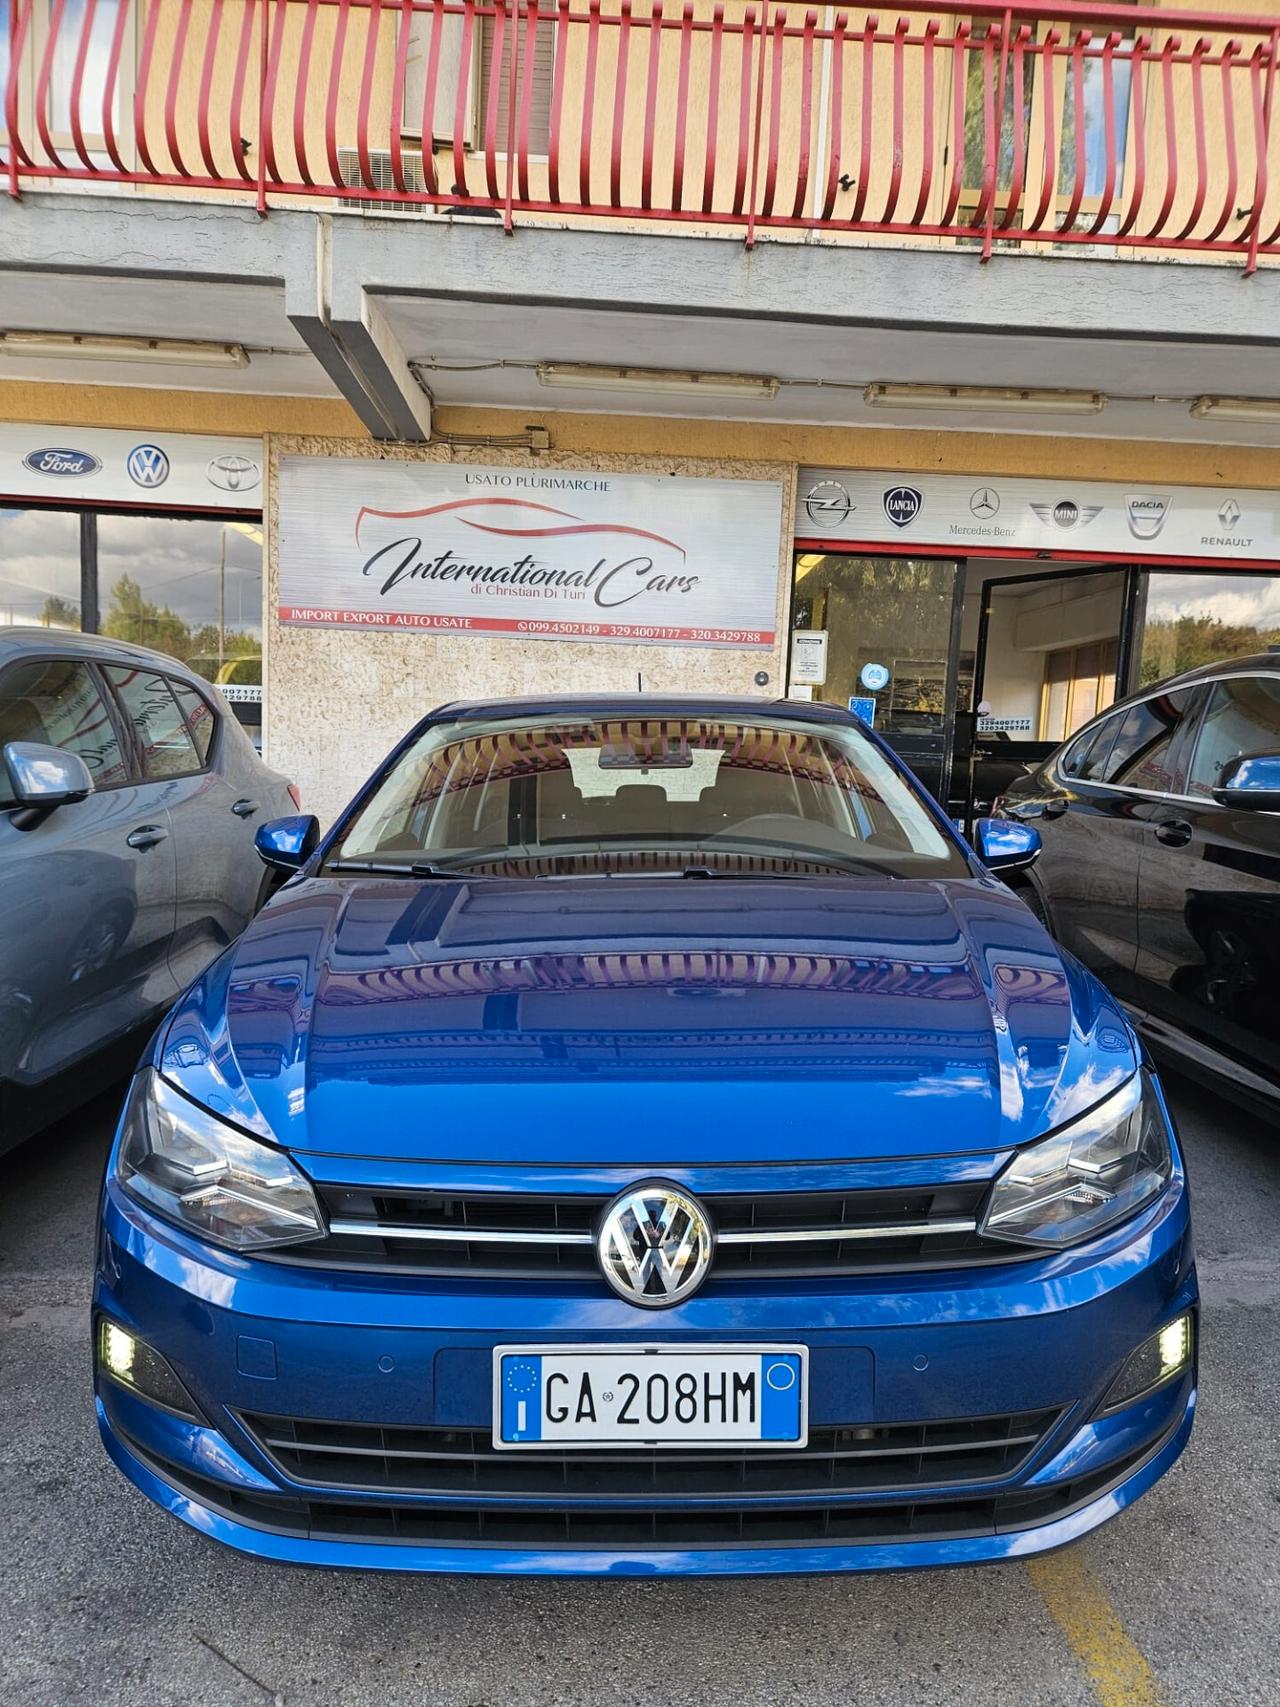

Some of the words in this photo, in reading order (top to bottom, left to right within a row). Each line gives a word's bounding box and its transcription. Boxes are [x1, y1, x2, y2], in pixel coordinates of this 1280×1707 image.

[39, 452, 84, 475] Ford
[465, 473, 512, 486] USATO
[516, 476, 611, 492] PLURIMARCHE
[889, 499, 915, 511] LANCIA
[1131, 500, 1164, 509] DACIA
[1054, 509, 1079, 520] MINI
[949, 525, 1016, 537] Mercedes-Benz
[1200, 537, 1253, 547] RENAULT
[363, 537, 607, 596] International
[594, 556, 702, 608] Cars
[471, 584, 483, 595] di
[486, 585, 540, 598] Christian
[544, 586, 558, 599] Di
[563, 588, 585, 600] Turi
[291, 609, 340, 621] IMPORT
[343, 612, 392, 624] EXPORT
[394, 614, 431, 627] AUTO
[433, 617, 473, 629] USATE
[529, 621, 600, 634] 099.4502149
[610, 626, 681, 639] 329.4007177
[690, 630, 761, 642] 320.3429788
[546, 1372, 597, 1423] GA
[617, 1372, 756, 1424] 208HM
